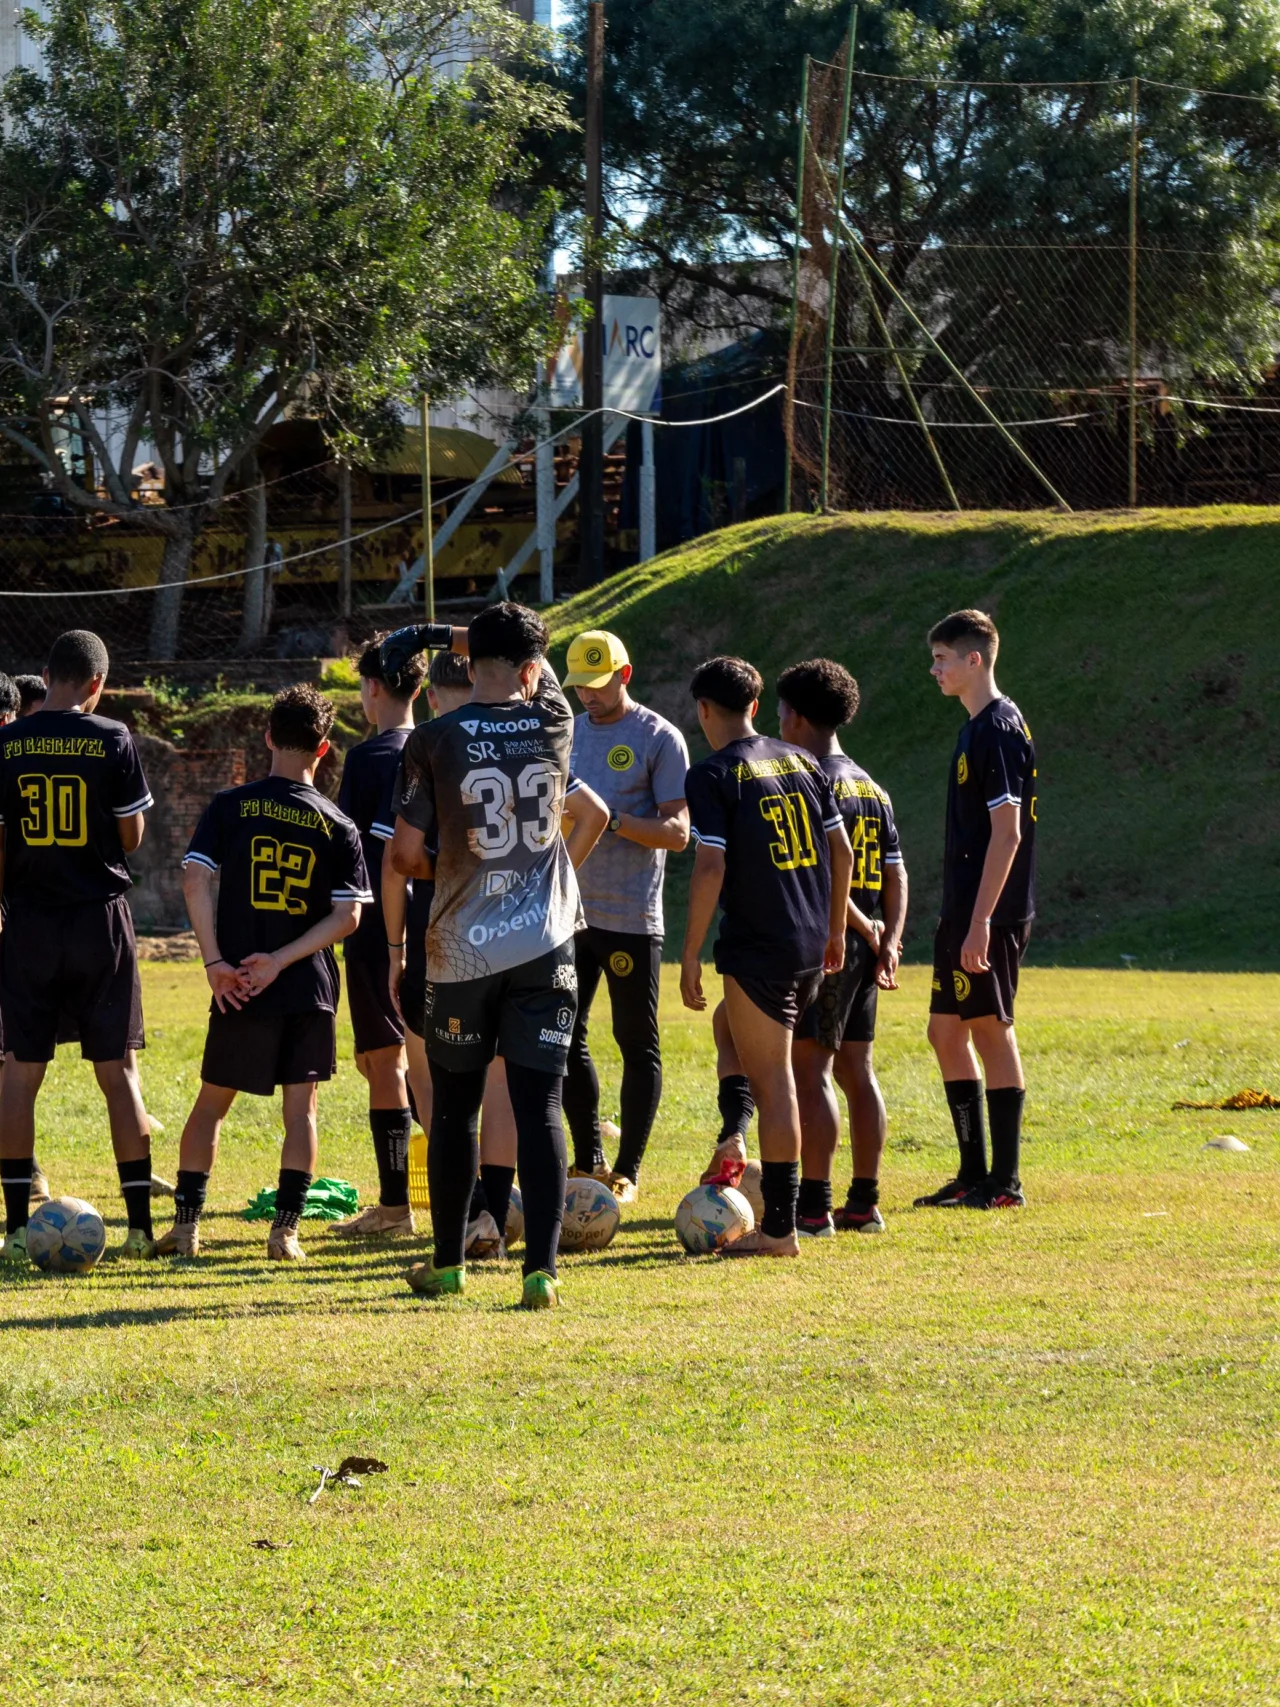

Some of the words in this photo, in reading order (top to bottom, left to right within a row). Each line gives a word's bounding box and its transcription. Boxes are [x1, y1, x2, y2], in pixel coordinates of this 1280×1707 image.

[480, 718, 541, 734] SICOOB
[23, 737, 106, 758] CASCAVEL
[466, 740, 501, 763] SR
[505, 744, 546, 756] REZENDE
[17, 773, 88, 847] 30
[240, 799, 260, 817] FC
[459, 761, 563, 861] 33
[759, 791, 818, 871] 31
[250, 835, 317, 915] 22
